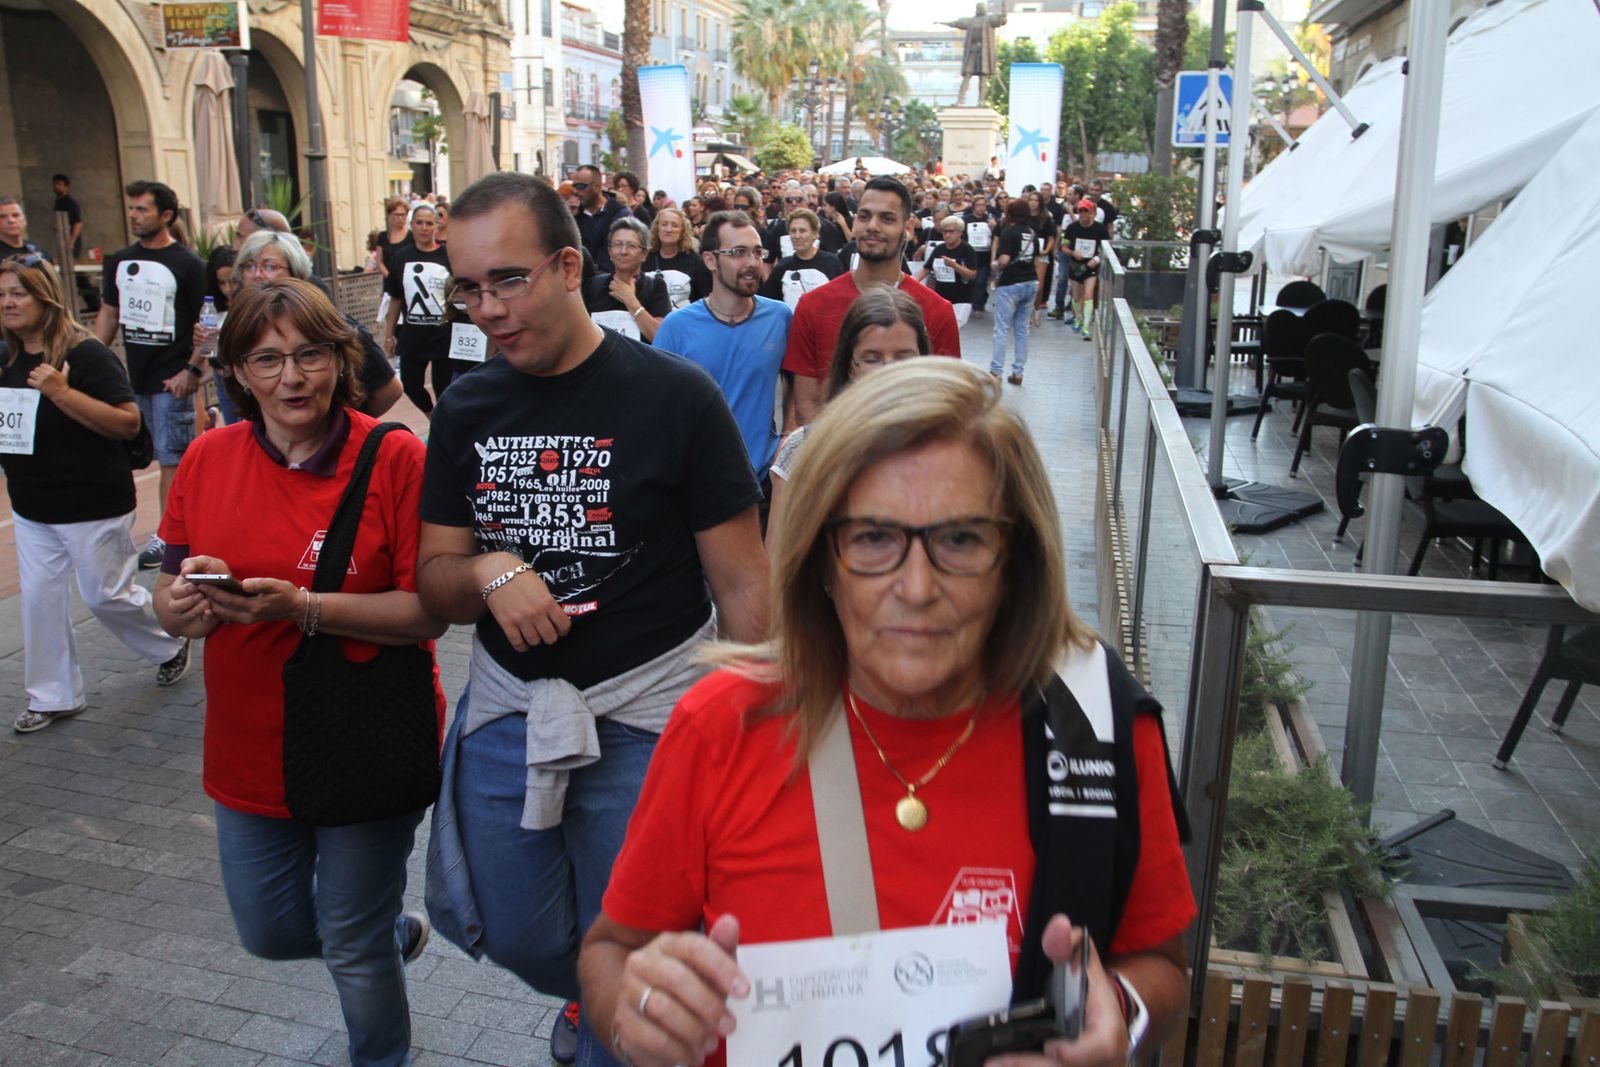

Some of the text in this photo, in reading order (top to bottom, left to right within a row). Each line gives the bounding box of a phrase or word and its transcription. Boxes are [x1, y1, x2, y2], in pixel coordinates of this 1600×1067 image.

[128, 297, 152, 312] 840
[458, 336, 478, 348] 832
[485, 436, 595, 449] AUTHENTIC
[502, 451, 537, 466] 1932
[562, 450, 611, 467] 1970
[480, 465, 518, 483] 1957
[546, 469, 577, 487] oil
[513, 478, 541, 489] 1965
[580, 478, 611, 491] 2008
[486, 490, 511, 502] 1982
[537, 490, 608, 503] motor oil
[474, 510, 494, 522] 1965
[487, 502, 587, 529] since 1853
[505, 526, 551, 537] motor
[528, 530, 616, 552] original
[563, 601, 598, 614] MOTUL
[1069, 757, 1117, 777] ILUNIO
